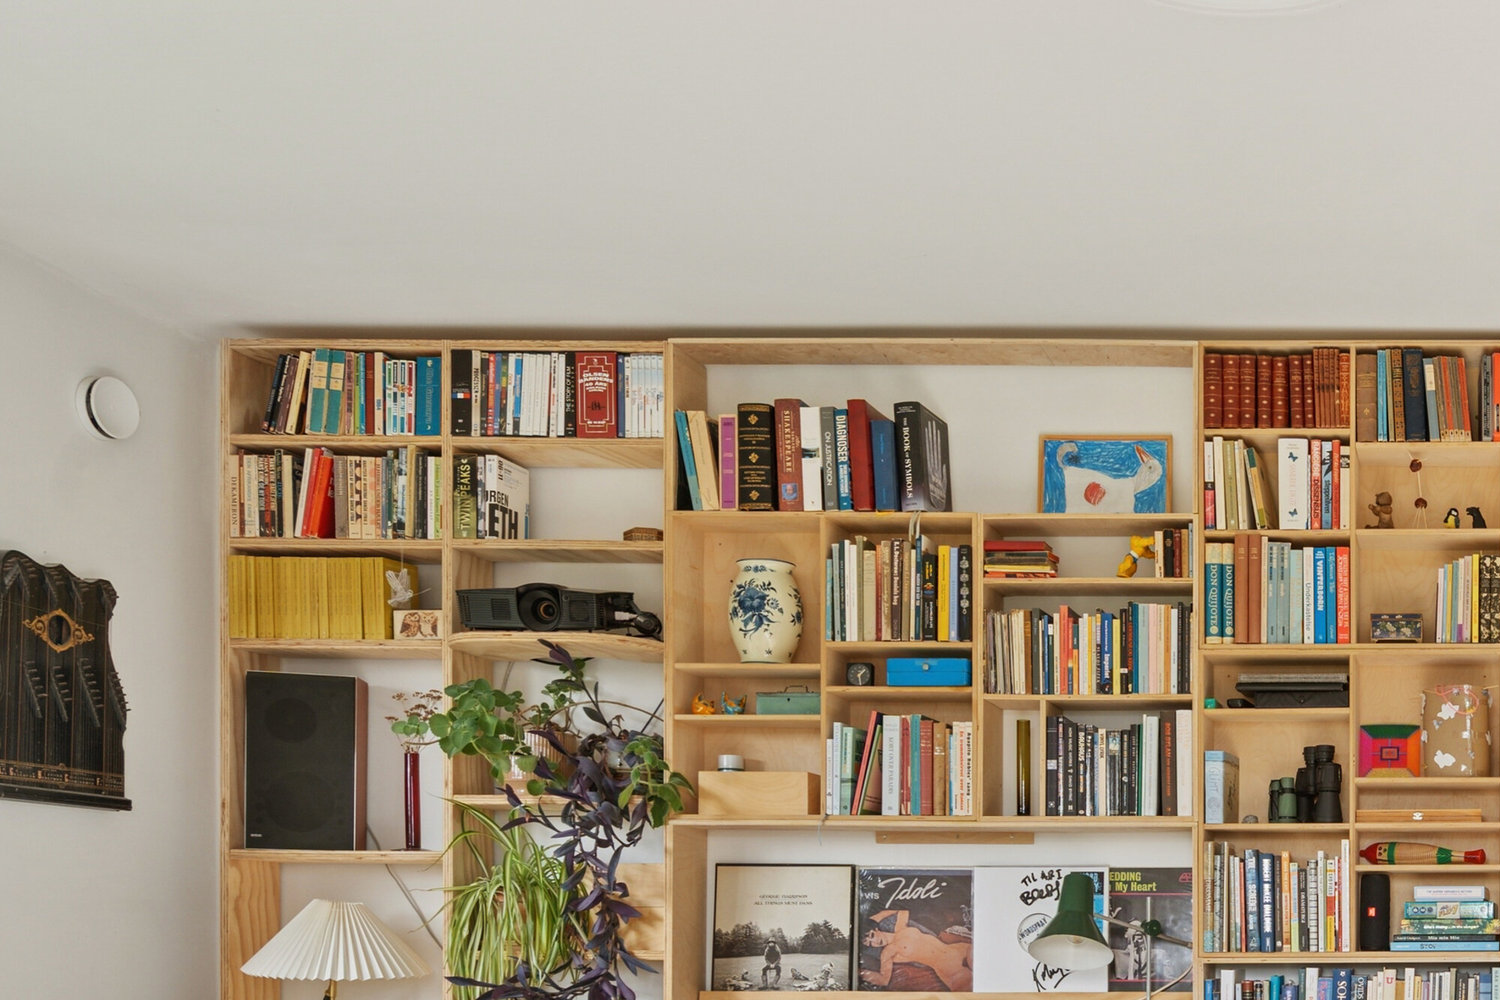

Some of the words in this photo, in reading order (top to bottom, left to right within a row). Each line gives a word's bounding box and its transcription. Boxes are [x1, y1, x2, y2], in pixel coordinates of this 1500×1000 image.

[784, 410, 792, 473] SHAKESPEARE
[825, 432, 832, 442] ON
[836, 416, 848, 462] DIAGNOSER
[902, 427, 912, 452] BOOK
[462, 463, 470, 496] PEAKS
[904, 458, 913, 498] SYMBOLS
[461, 497, 470, 528] TWIN
[1312, 479, 1320, 519] DISSENSUS
[486, 502, 519, 539] ETH
[1210, 565, 1218, 586] DON
[1208, 588, 1218, 627] QUIJOTE
[1224, 588, 1234, 627] QUIJOTE
[1304, 582, 1313, 632] Underkastelse
[1164, 722, 1172, 737] BOB
[1164, 738, 1172, 757] DYLAN
[1020, 872, 1037, 887] TIL
[1262, 858, 1273, 882] ROBERT
[878, 877, 948, 908] Idoli
[1115, 882, 1128, 892] My
[1130, 881, 1157, 891] Heart
[1262, 904, 1273, 932] DIALOGUE
